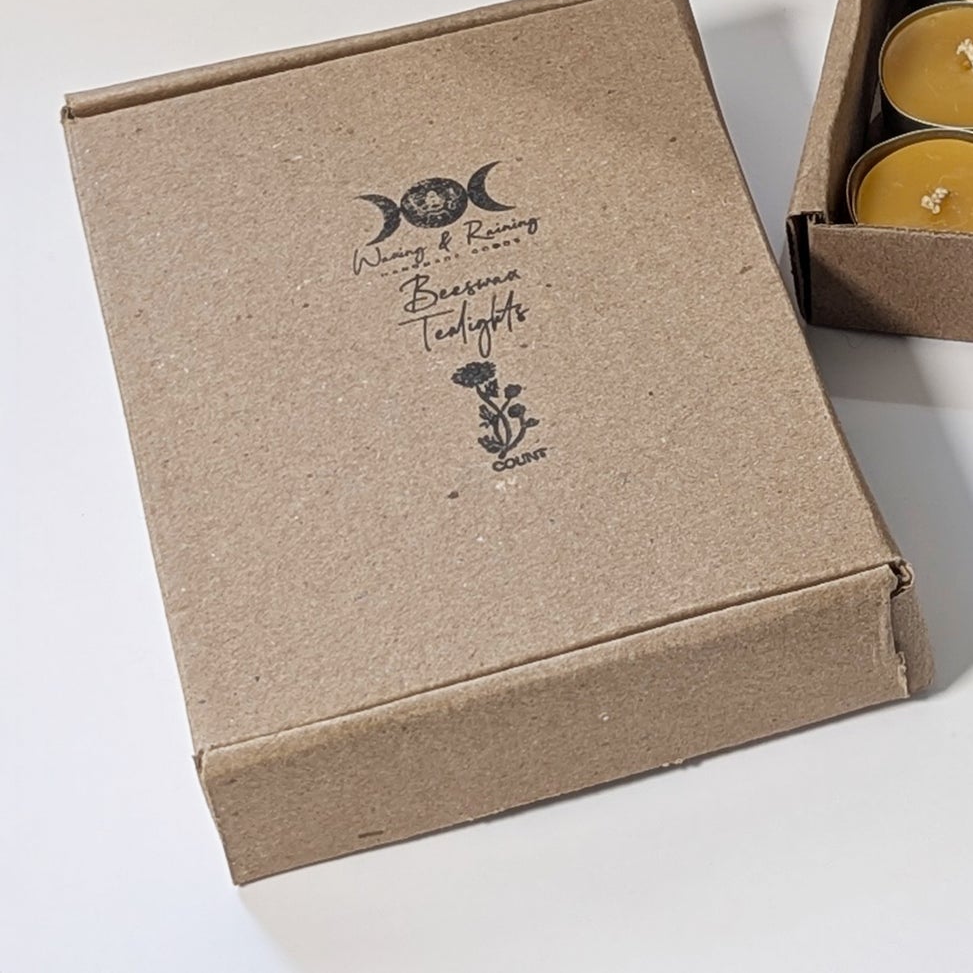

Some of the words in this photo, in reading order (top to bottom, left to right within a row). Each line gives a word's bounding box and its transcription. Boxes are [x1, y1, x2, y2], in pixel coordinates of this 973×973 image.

[438, 230, 452, 252] &
[463, 216, 541, 245] Raining
[399, 268, 521, 314] Beeswax
[398, 289, 530, 358] Tealights
[491, 447, 548, 472] COUNT
